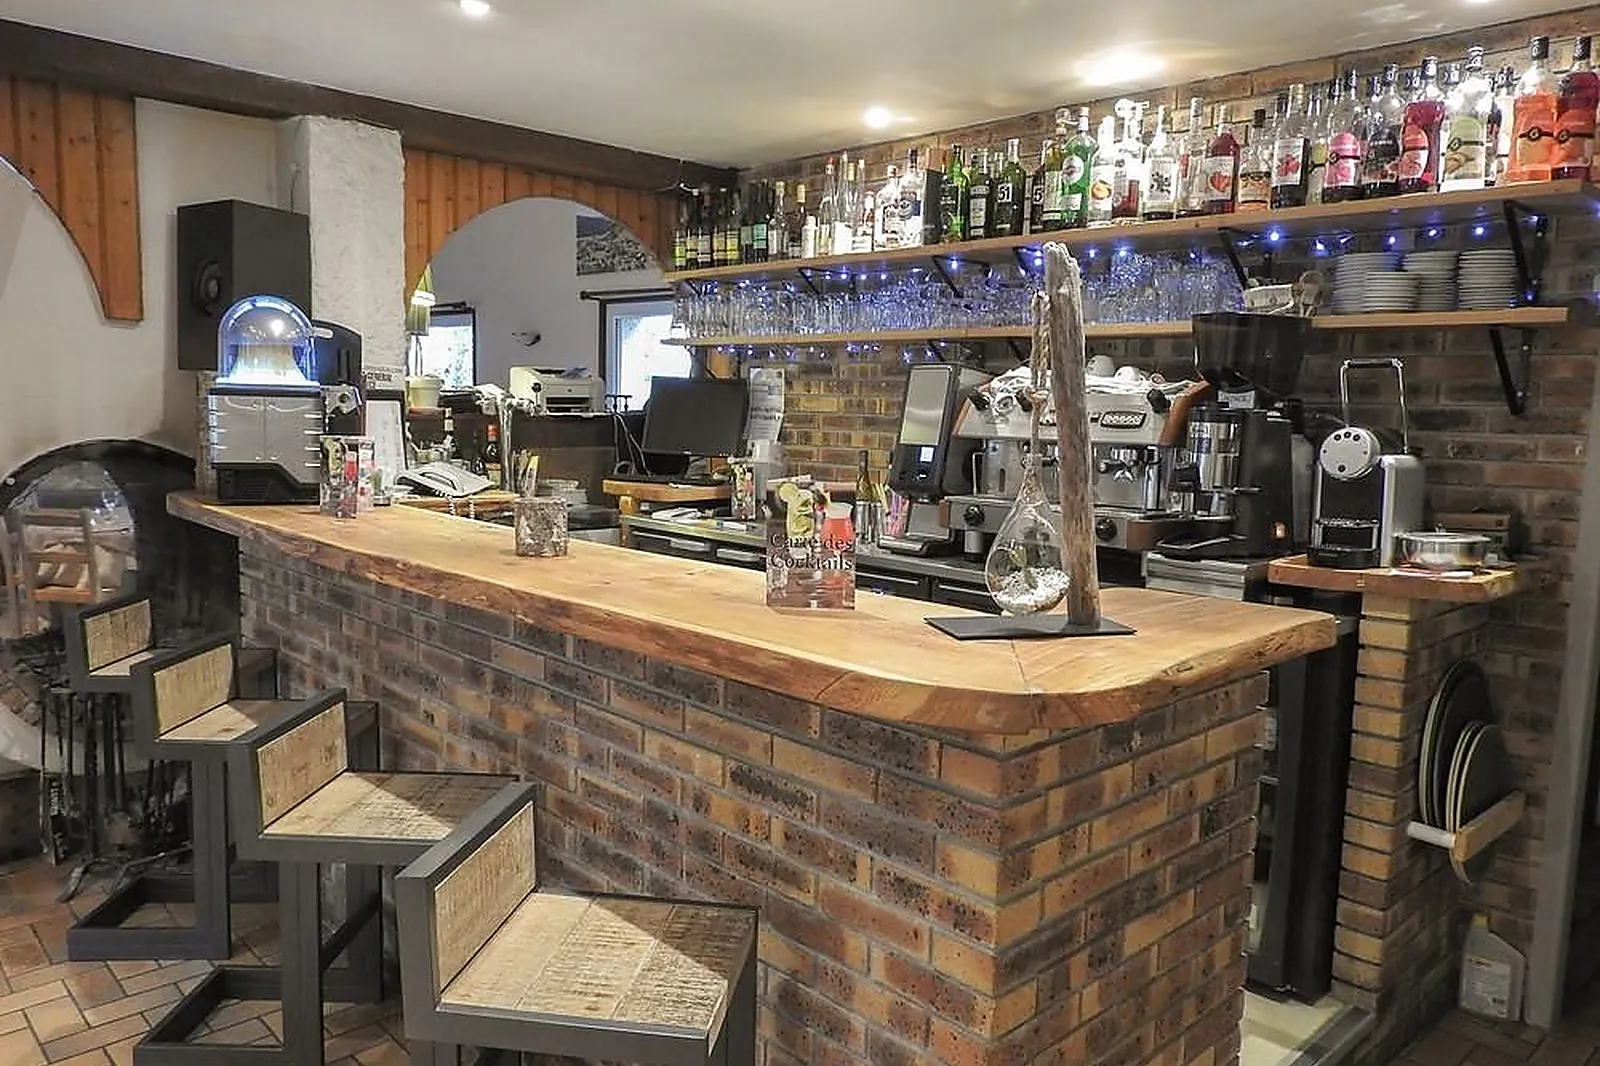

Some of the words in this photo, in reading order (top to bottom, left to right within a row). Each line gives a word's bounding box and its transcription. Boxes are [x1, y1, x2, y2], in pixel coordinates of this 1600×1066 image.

[999, 186, 1011, 200] 51
[771, 534, 820, 549] Carte
[824, 534, 852, 550] des
[771, 553, 852, 570] Cocktails
